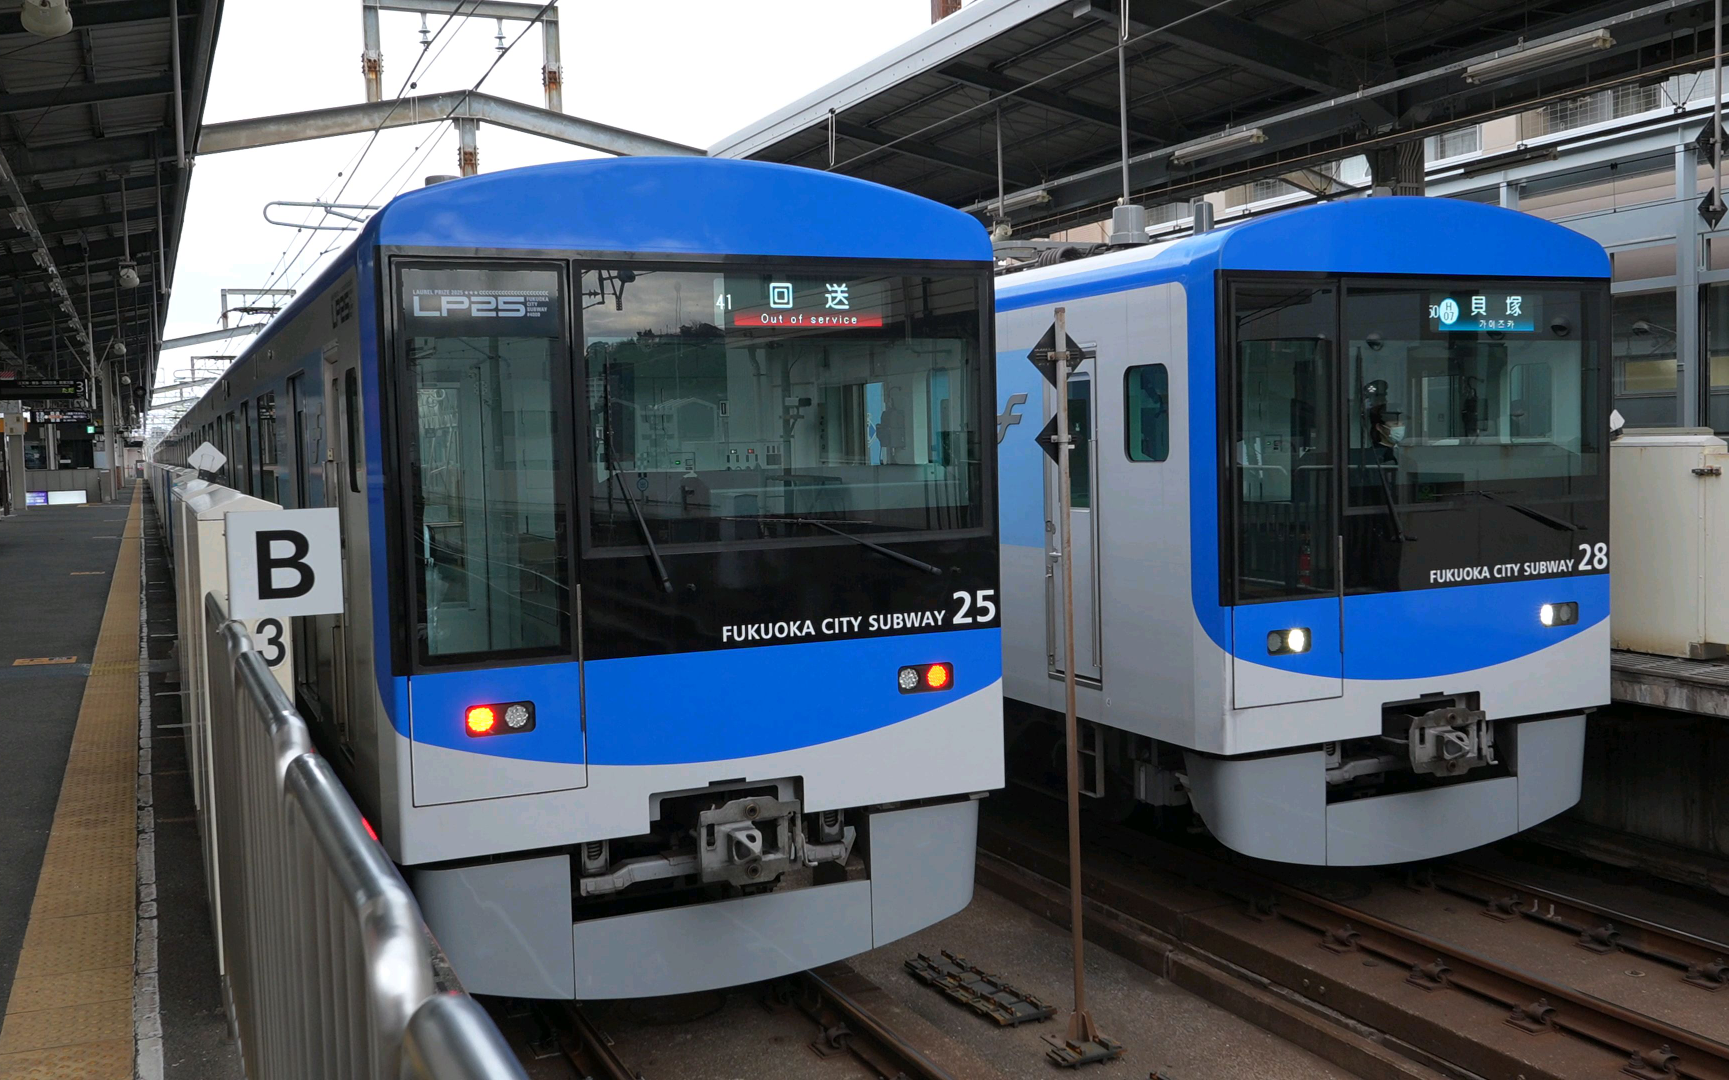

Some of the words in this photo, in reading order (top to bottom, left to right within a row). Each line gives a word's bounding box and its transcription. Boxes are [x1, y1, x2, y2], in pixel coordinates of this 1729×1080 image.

[413, 296, 526, 317] LP25
[716, 294, 732, 310] 41
[769, 283, 849, 309] 回送
[1445, 302, 1452, 311] H
[1470, 295, 1522, 316] 貝塚
[760, 314, 783, 324] Out
[790, 314, 803, 324] of
[810, 315, 857, 324] service
[1443, 312, 1454, 321] 07
[76, 381, 84, 392] 3
[255, 529, 315, 600] B
[1429, 566, 1490, 583] FUKUOKA
[1493, 563, 1520, 578] CITY
[1523, 559, 1575, 576] SUBWAY
[1578, 542, 1608, 571] 28
[722, 620, 815, 642] FUKUOKA
[821, 616, 862, 634] CITY
[868, 610, 946, 631] SUBWAY
[952, 589, 996, 624] 25
[256, 617, 286, 667] 3
